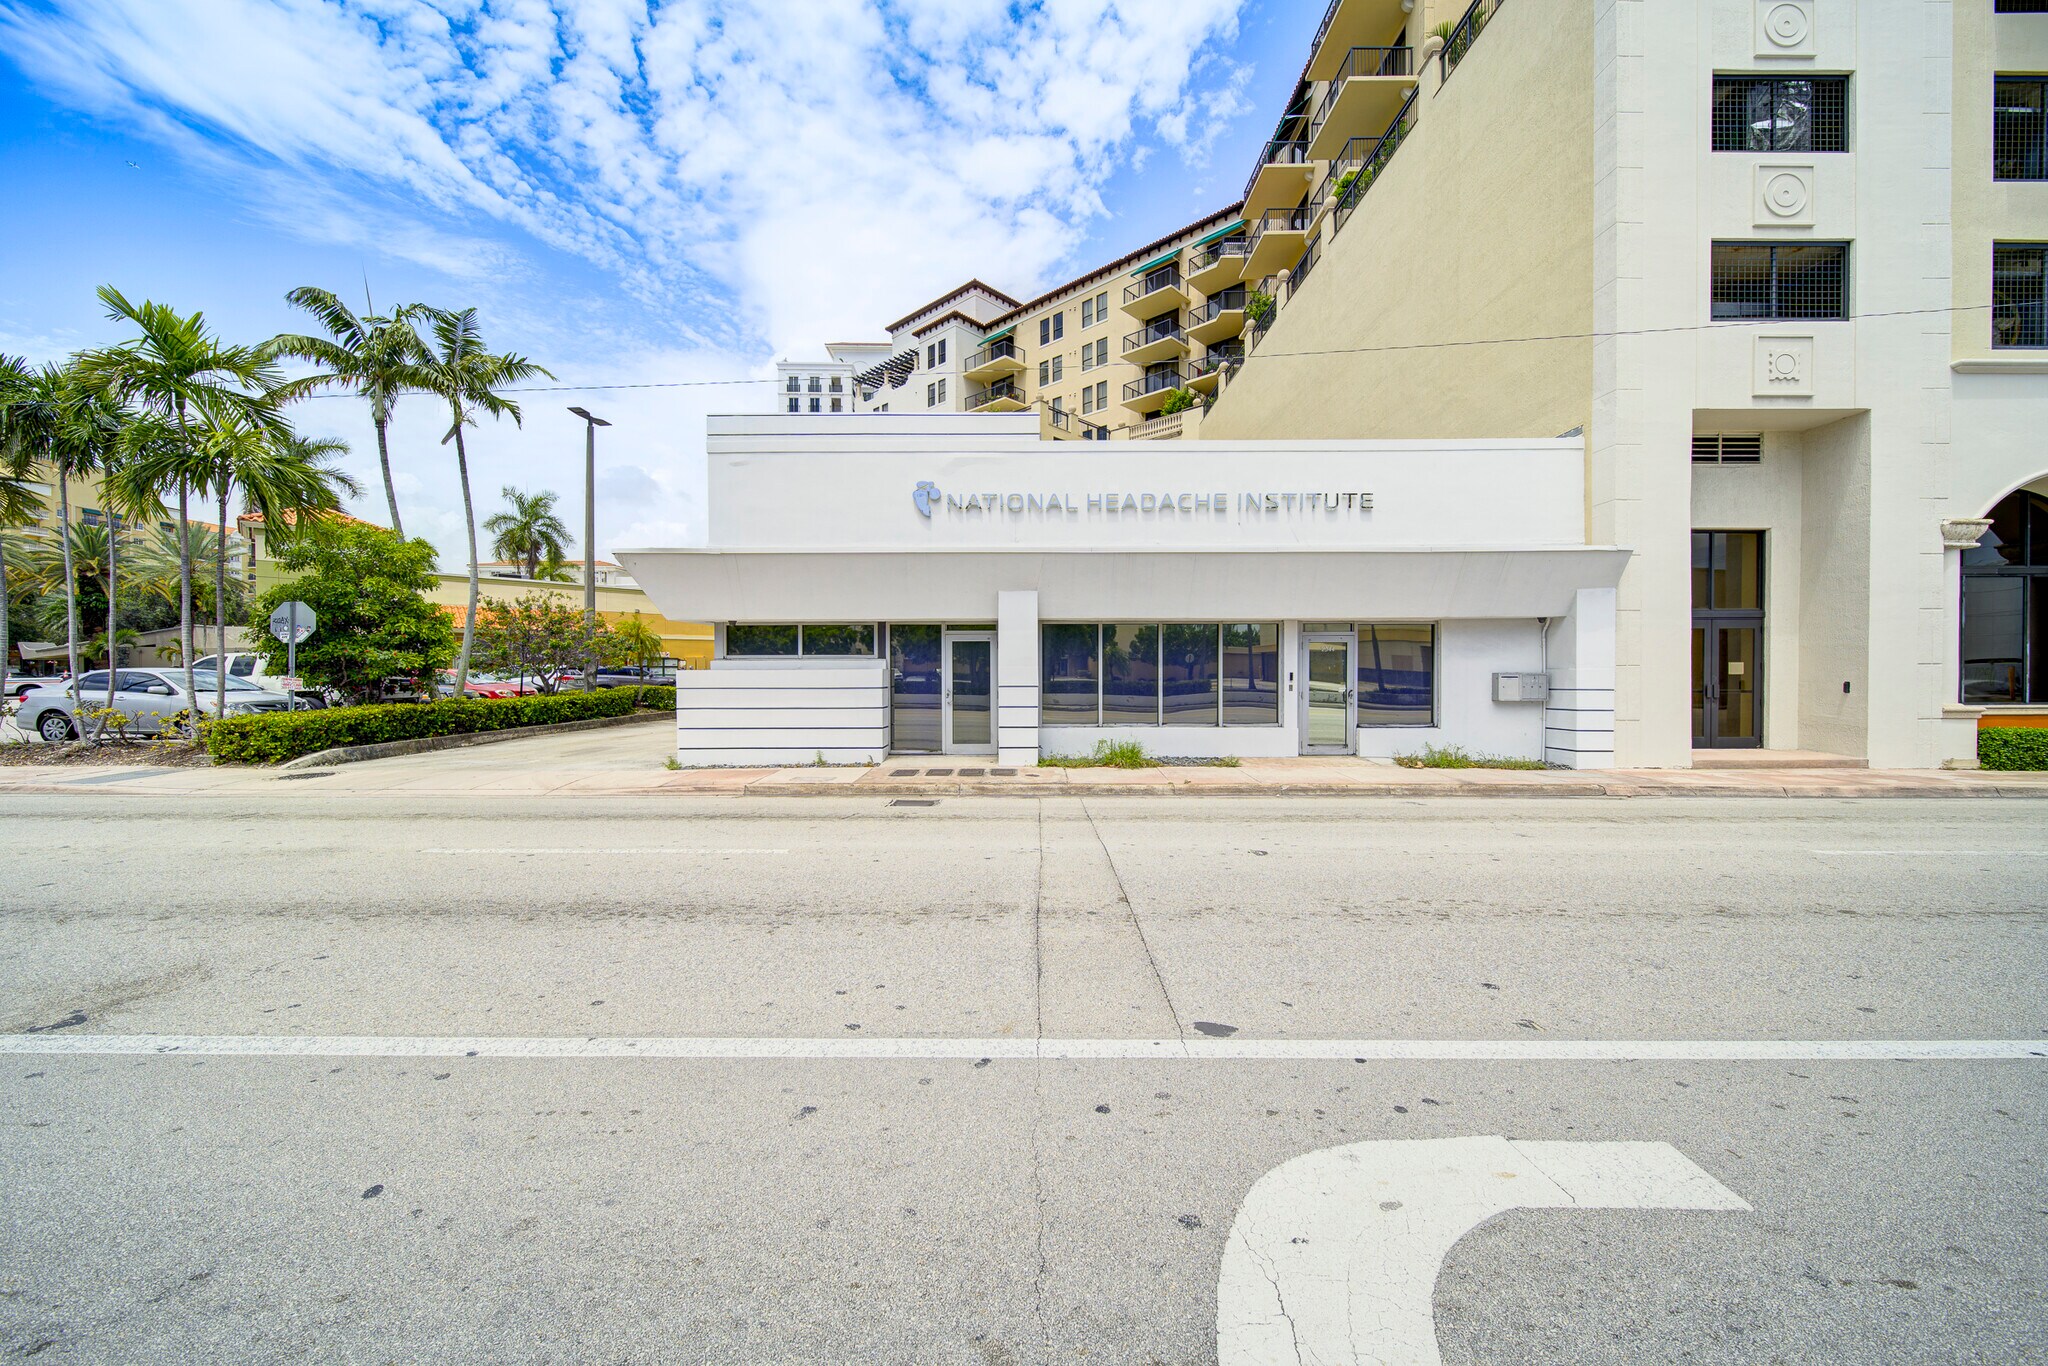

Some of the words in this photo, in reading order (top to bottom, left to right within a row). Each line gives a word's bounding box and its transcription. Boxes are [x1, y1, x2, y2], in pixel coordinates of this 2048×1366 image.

[947, 493, 1078, 512] NATIONAL
[1087, 493, 1227, 512] HEADACHE
[1238, 493, 1374, 512] INSTITUTE
